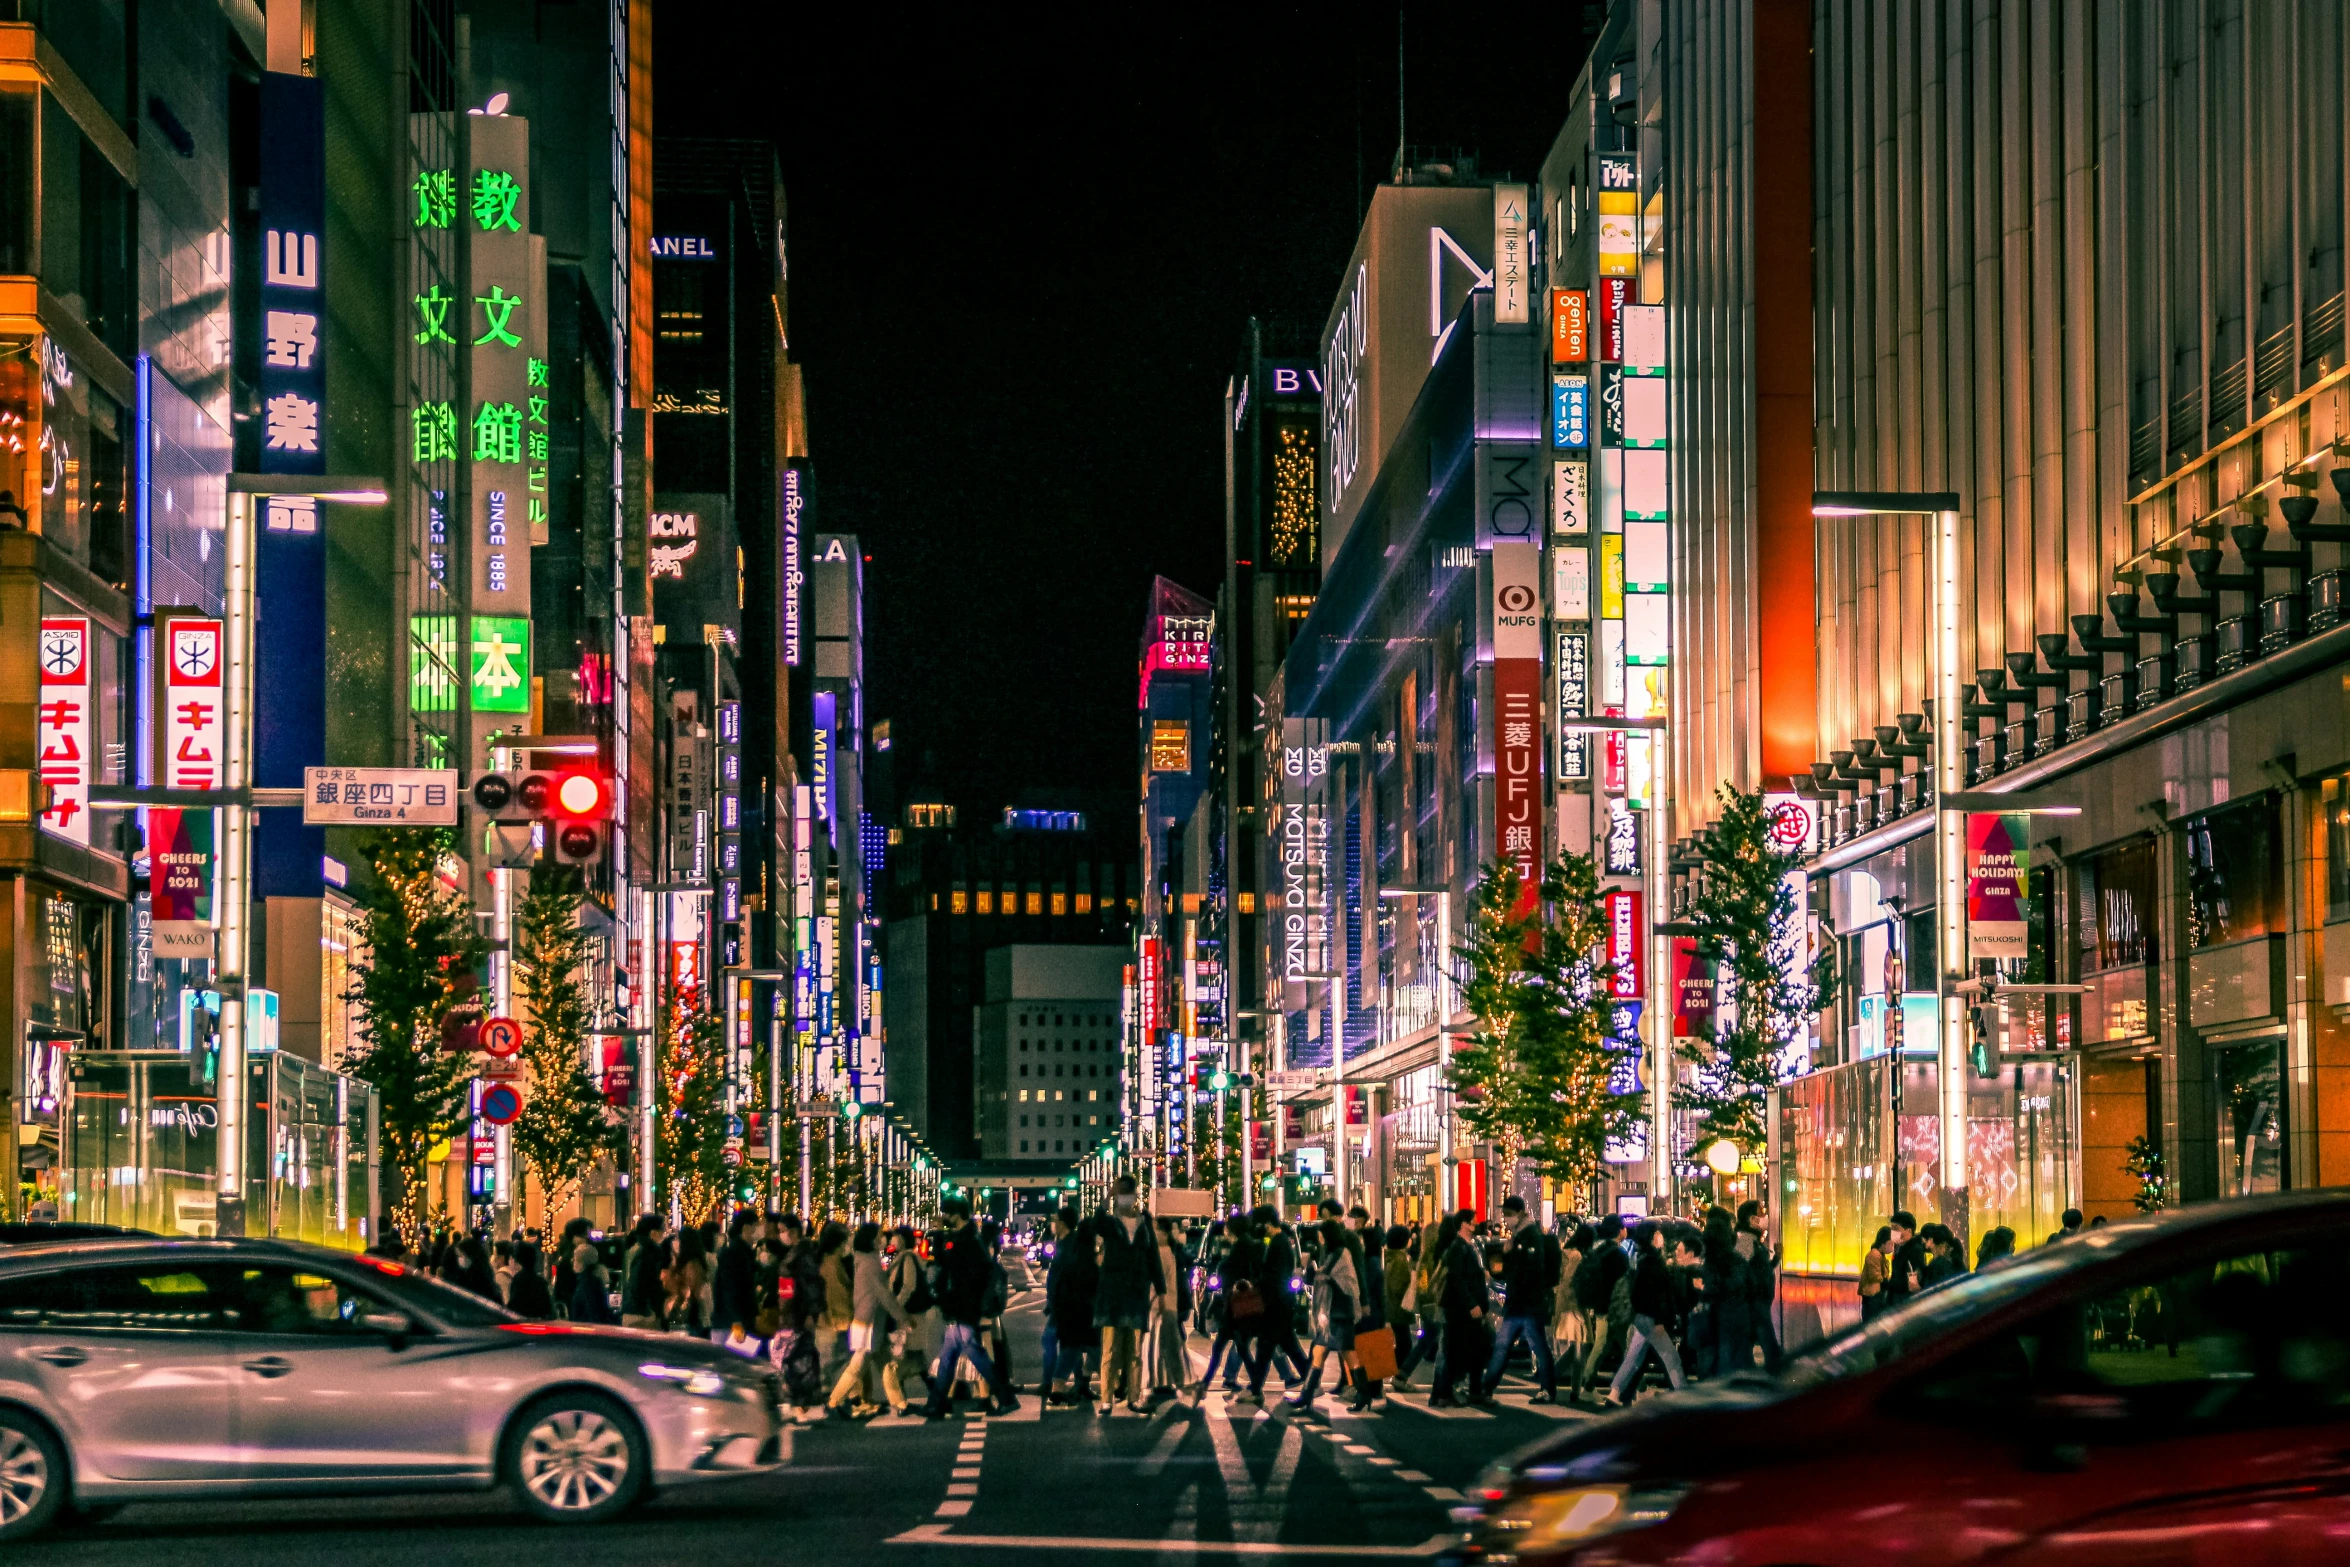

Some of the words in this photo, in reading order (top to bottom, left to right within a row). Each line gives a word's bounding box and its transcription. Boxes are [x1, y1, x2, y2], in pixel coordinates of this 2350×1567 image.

[1504, 227, 1519, 310] 三幸エステート
[472, 169, 523, 463] 教文館
[1558, 380, 1583, 388] AEON
[1570, 392, 1582, 429] 英会話
[1558, 392, 1569, 443] イーオン
[1578, 466, 1586, 497] 日本料理
[1562, 465, 1577, 527] ざくろ
[491, 491, 505, 545] SINCE
[491, 553, 505, 592] 1885
[1498, 616, 1536, 626] MUFG
[473, 632, 521, 697] 本
[316, 768, 357, 781] 中央区
[316, 782, 446, 806] 銀座四丁目
[354, 806, 392, 819] Ginza
[397, 807, 406, 819] 4
[159, 853, 207, 865] CHEERS
[1979, 855, 2017, 865] HAPPY
[176, 867, 189, 875] TO
[1631, 868, 1641, 876] 2F
[1971, 867, 2025, 878] HOLIDAYS
[168, 877, 199, 888] 2021
[1985, 887, 2011, 895] GINZA
[163, 933, 205, 946] WAKO
[1679, 979, 1714, 988] CHEERS
[862, 983, 871, 1019] ALBION
[1686, 998, 1709, 1008] 2021
